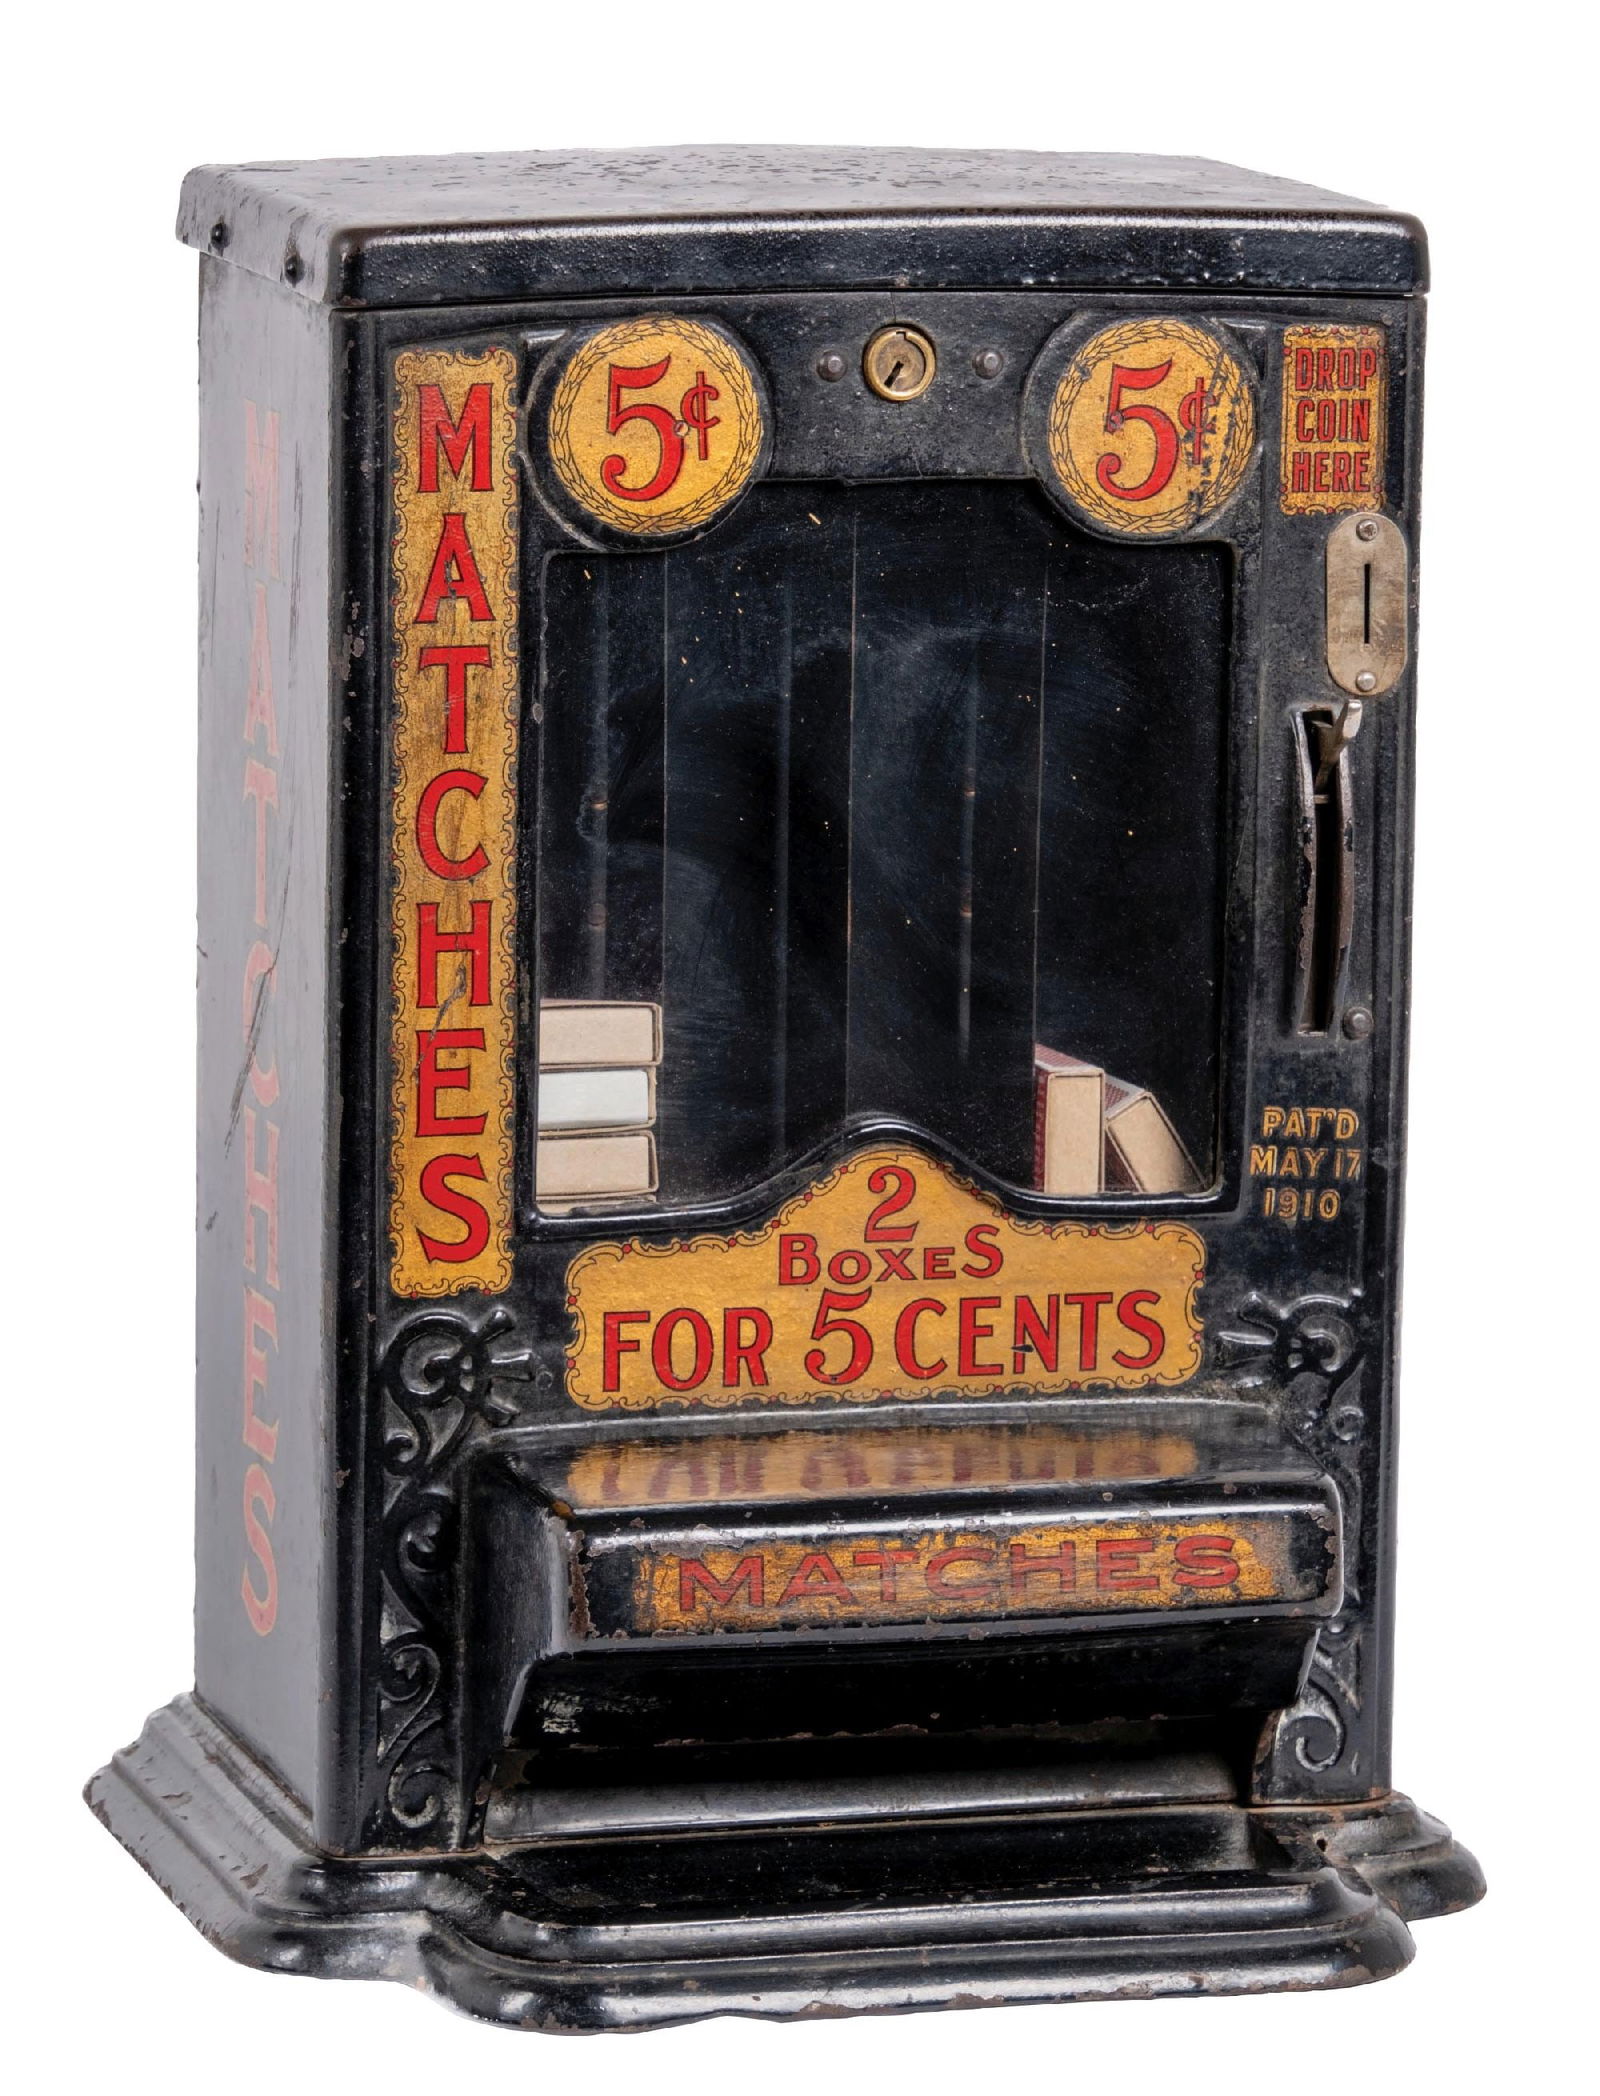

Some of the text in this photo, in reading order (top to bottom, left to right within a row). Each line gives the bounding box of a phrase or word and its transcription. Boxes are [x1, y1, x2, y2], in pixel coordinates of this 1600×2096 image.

[1294, 347, 1376, 391] DROP
[1295, 399, 1370, 443] COIN
[1291, 452, 1370, 493] HERE
[414, 382, 496, 1265] MATCHES
[241, 400, 281, 1636] MATCHES
[1249, 1144, 1362, 1179] MAY 17
[864, 1165, 919, 1243] 2
[1263, 1186, 1340, 1221] 1910
[601, 1287, 1165, 1392] FOR 5 CENTS
[679, 1536, 1240, 1612] MATCHES
